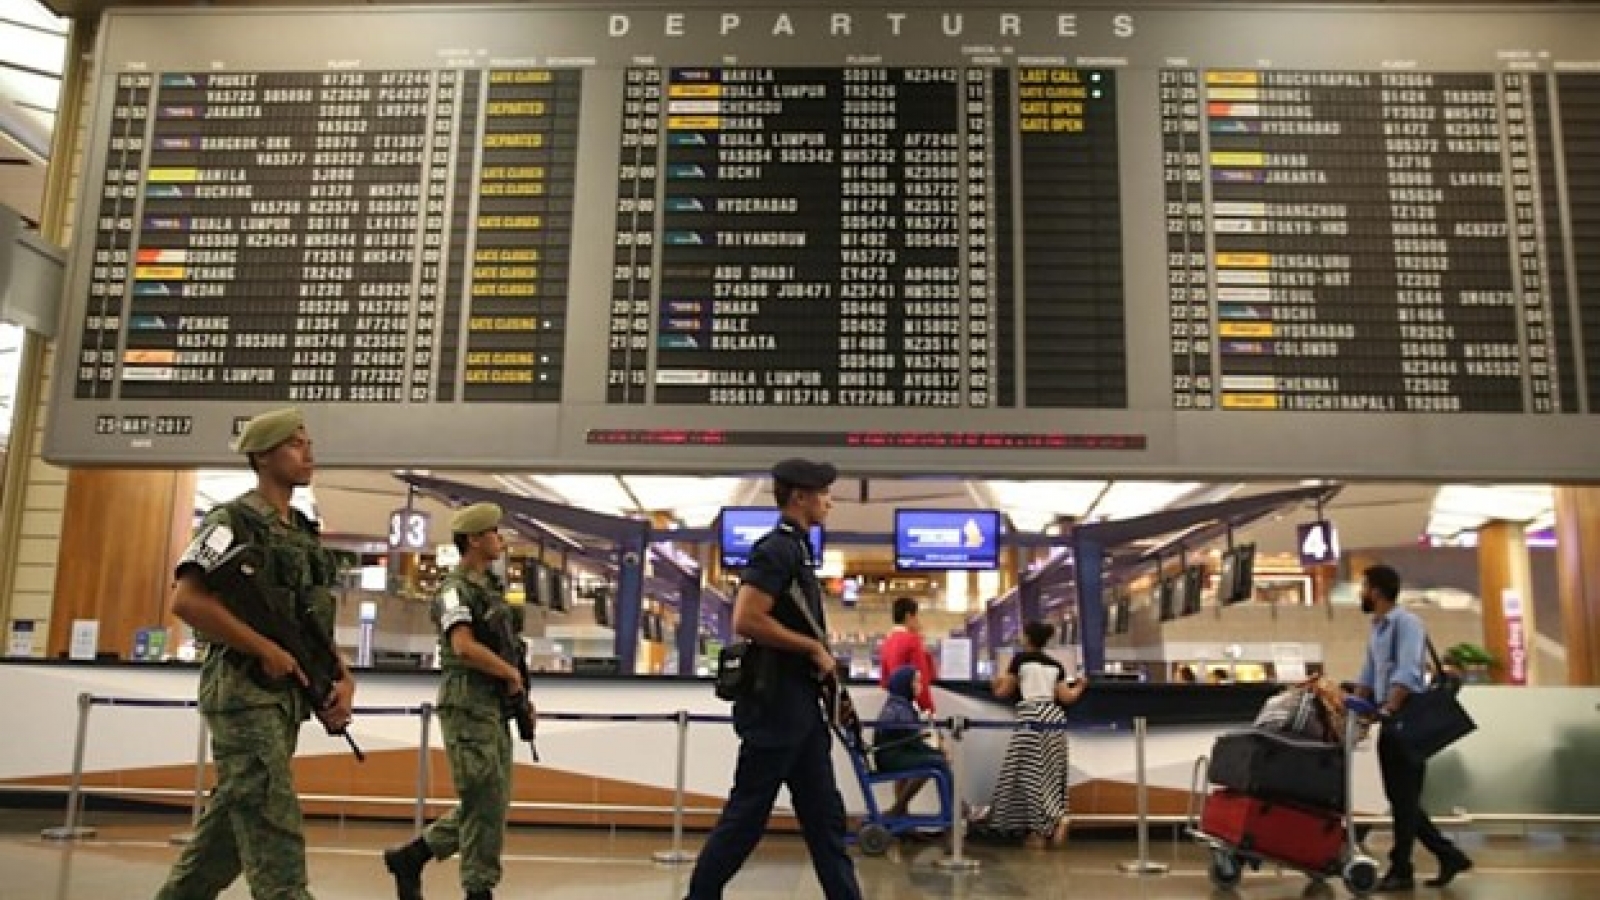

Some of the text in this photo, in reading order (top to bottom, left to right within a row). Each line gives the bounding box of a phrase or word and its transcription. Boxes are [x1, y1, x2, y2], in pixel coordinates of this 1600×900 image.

[608, 14, 1136, 37] DEPARTURES
[722, 69, 773, 82] MANILA
[1020, 69, 1047, 82] LAST
[1050, 69, 1078, 82] CALL
[722, 85, 764, 98] KUALA
[773, 85, 826, 98] LUMPUR
[205, 106, 262, 118] JAKARTA
[1020, 102, 1048, 115] GATE
[1050, 102, 1084, 115] OPEN
[1020, 118, 1048, 131] GATE
[1050, 118, 1084, 131] OPEN
[720, 133, 764, 146] KUALA
[772, 133, 825, 146] LUMPUR
[718, 165, 760, 179] KOCHI
[1266, 170, 1326, 183] JAKARTA
[717, 198, 798, 212] HYDERABAD
[191, 217, 232, 229] KUALA
[240, 217, 290, 229] LUMPUR
[717, 232, 806, 245] TRIVANDRUM
[187, 267, 235, 280] PENANG
[714, 266, 742, 280] ABU
[750, 266, 795, 280] DHABI
[712, 301, 760, 314] DHAKA
[1272, 306, 1316, 319] KOCHI
[179, 317, 229, 330] PENANG
[712, 318, 747, 332] MALE
[1273, 324, 1355, 337] HYDERABAD
[711, 336, 777, 350] KOLKATA
[1274, 341, 1338, 355] COLOMBO
[173, 368, 215, 382] KUALA
[222, 368, 274, 382] LUMPUR
[709, 370, 756, 384] KUALA
[765, 370, 821, 384] LUMPUR
[1276, 377, 1339, 391] CHENNAI
[407, 515, 424, 547] 3
[1302, 526, 1328, 560] 4
